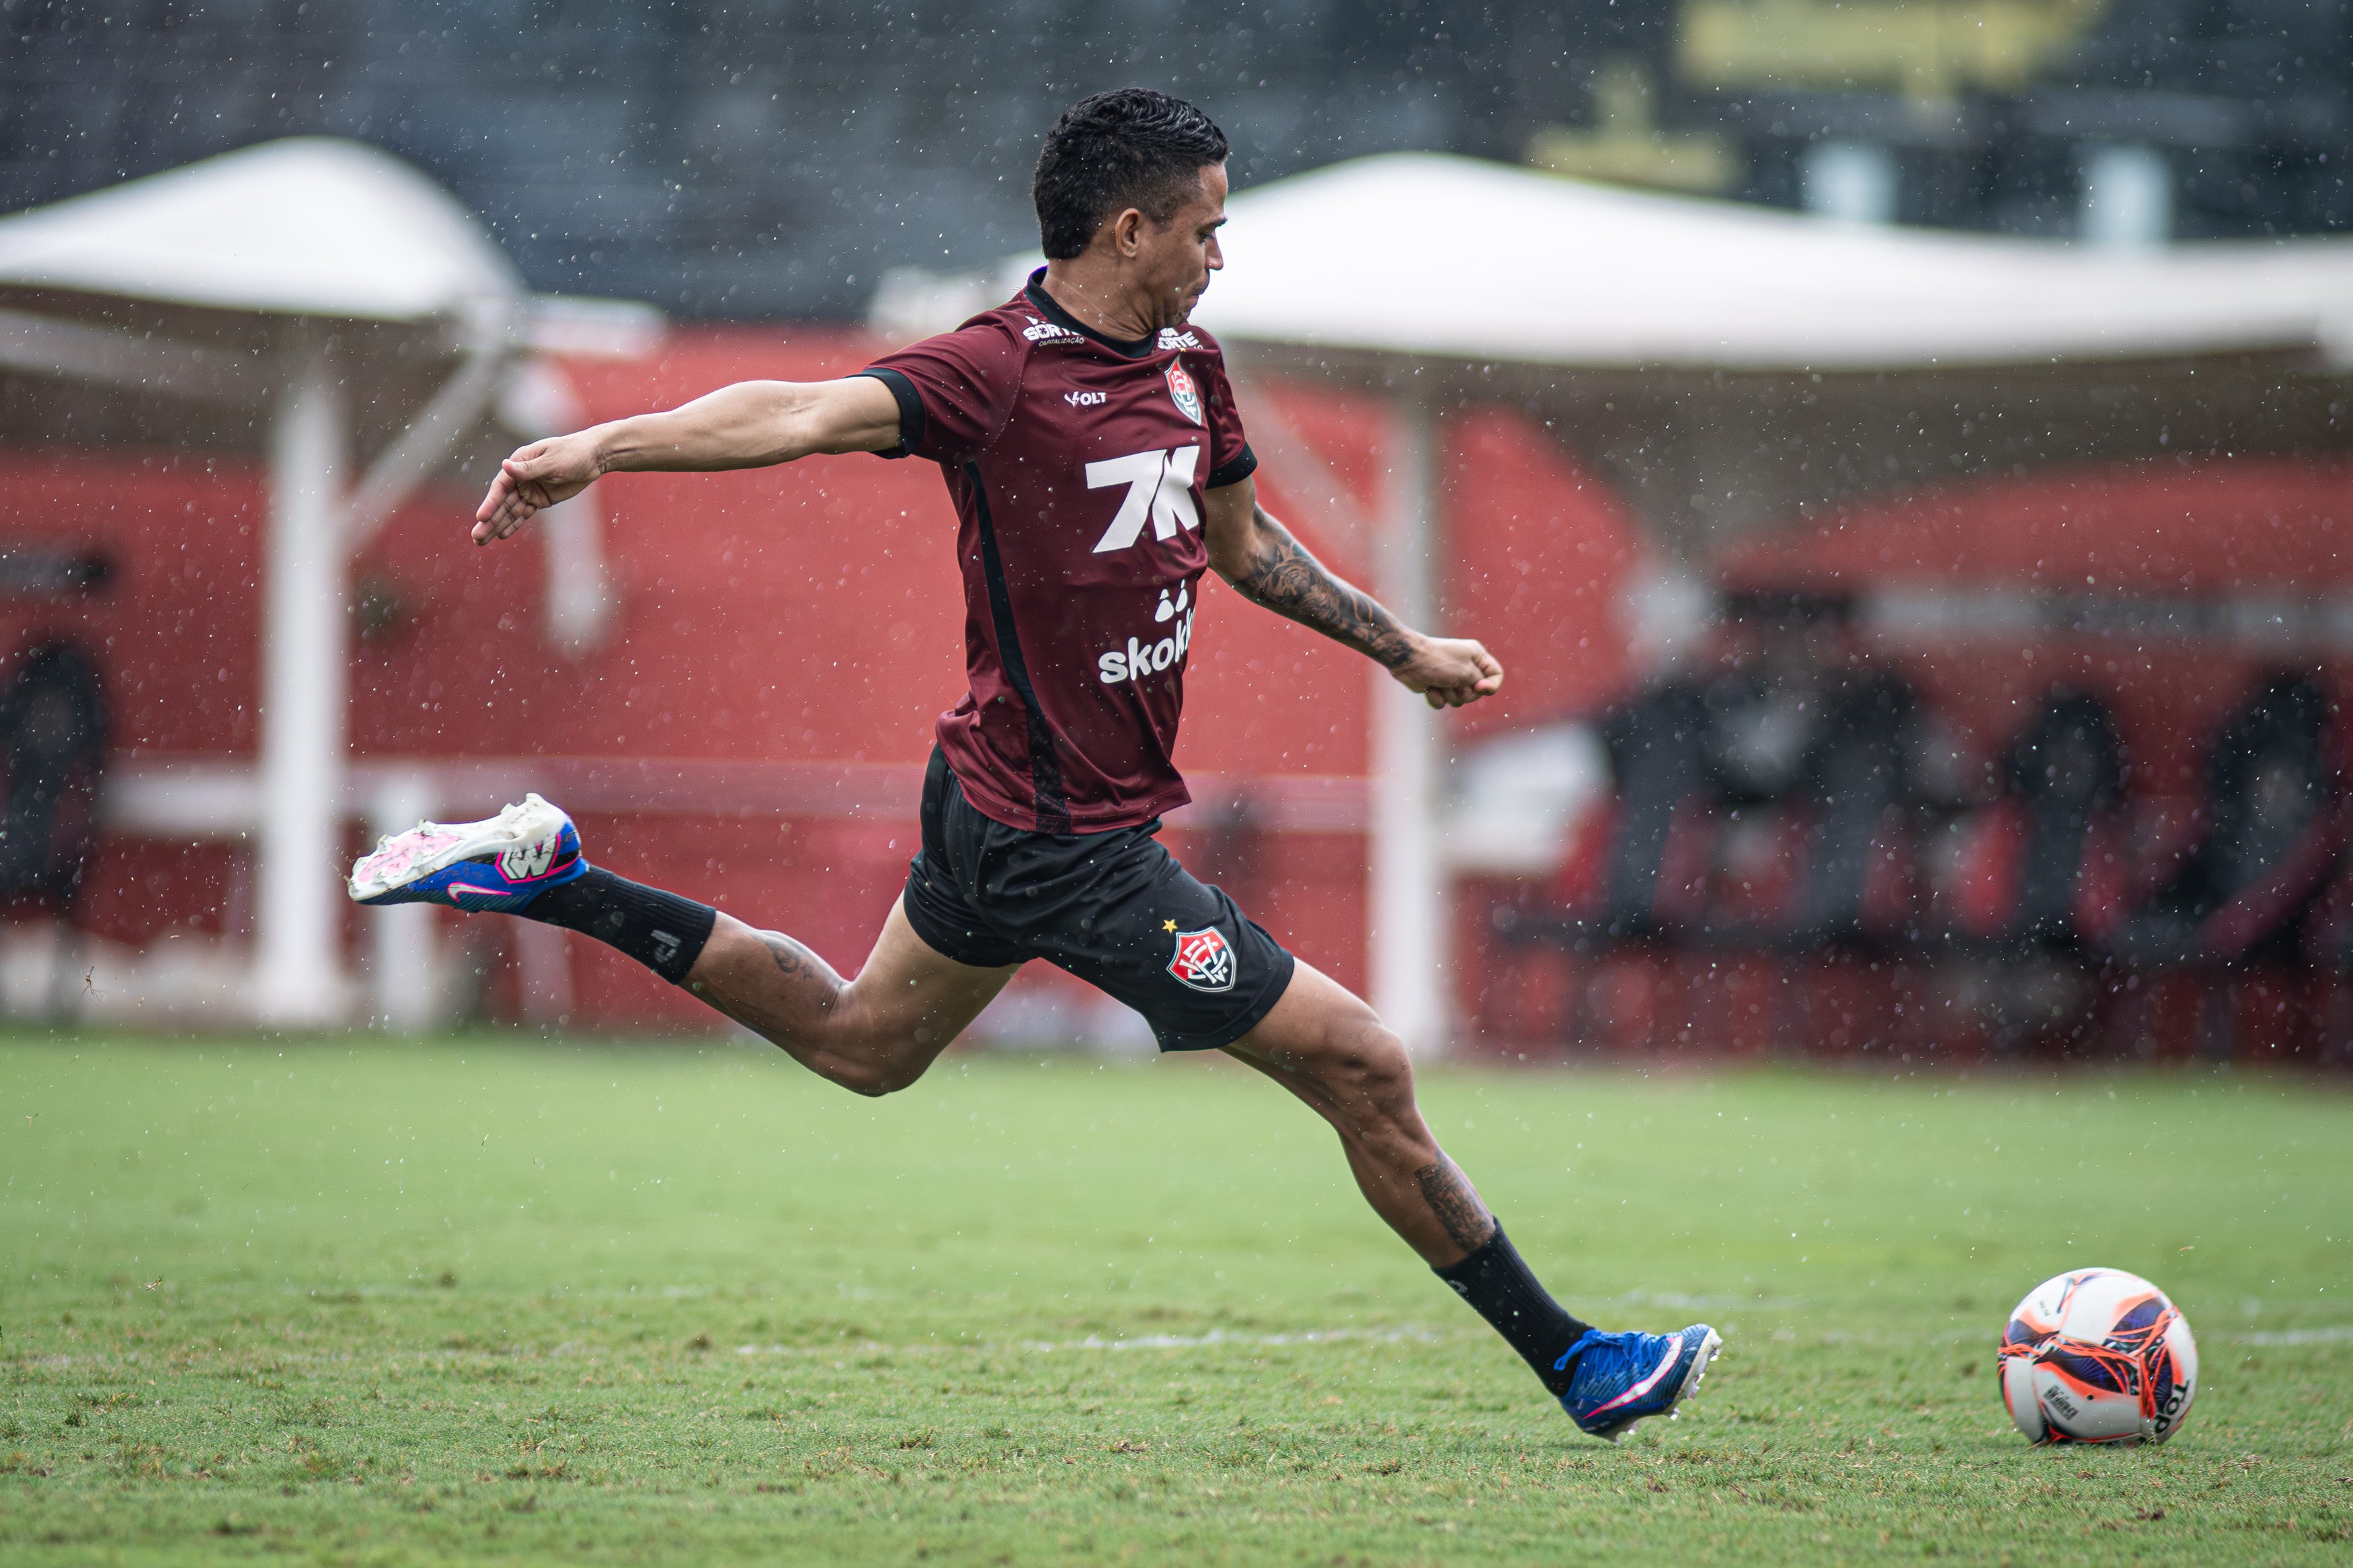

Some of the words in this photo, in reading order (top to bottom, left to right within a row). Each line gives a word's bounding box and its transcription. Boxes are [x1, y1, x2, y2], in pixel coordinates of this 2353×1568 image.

[1023, 323, 1082, 341] SOR
[1157, 331, 1199, 350] ORTE
[1039, 336, 1084, 347] CAPITALIZAÇÃO
[1064, 390, 1107, 408] VOLT
[1084, 445, 1201, 554] 7K
[1098, 605, 1196, 684] skokk
